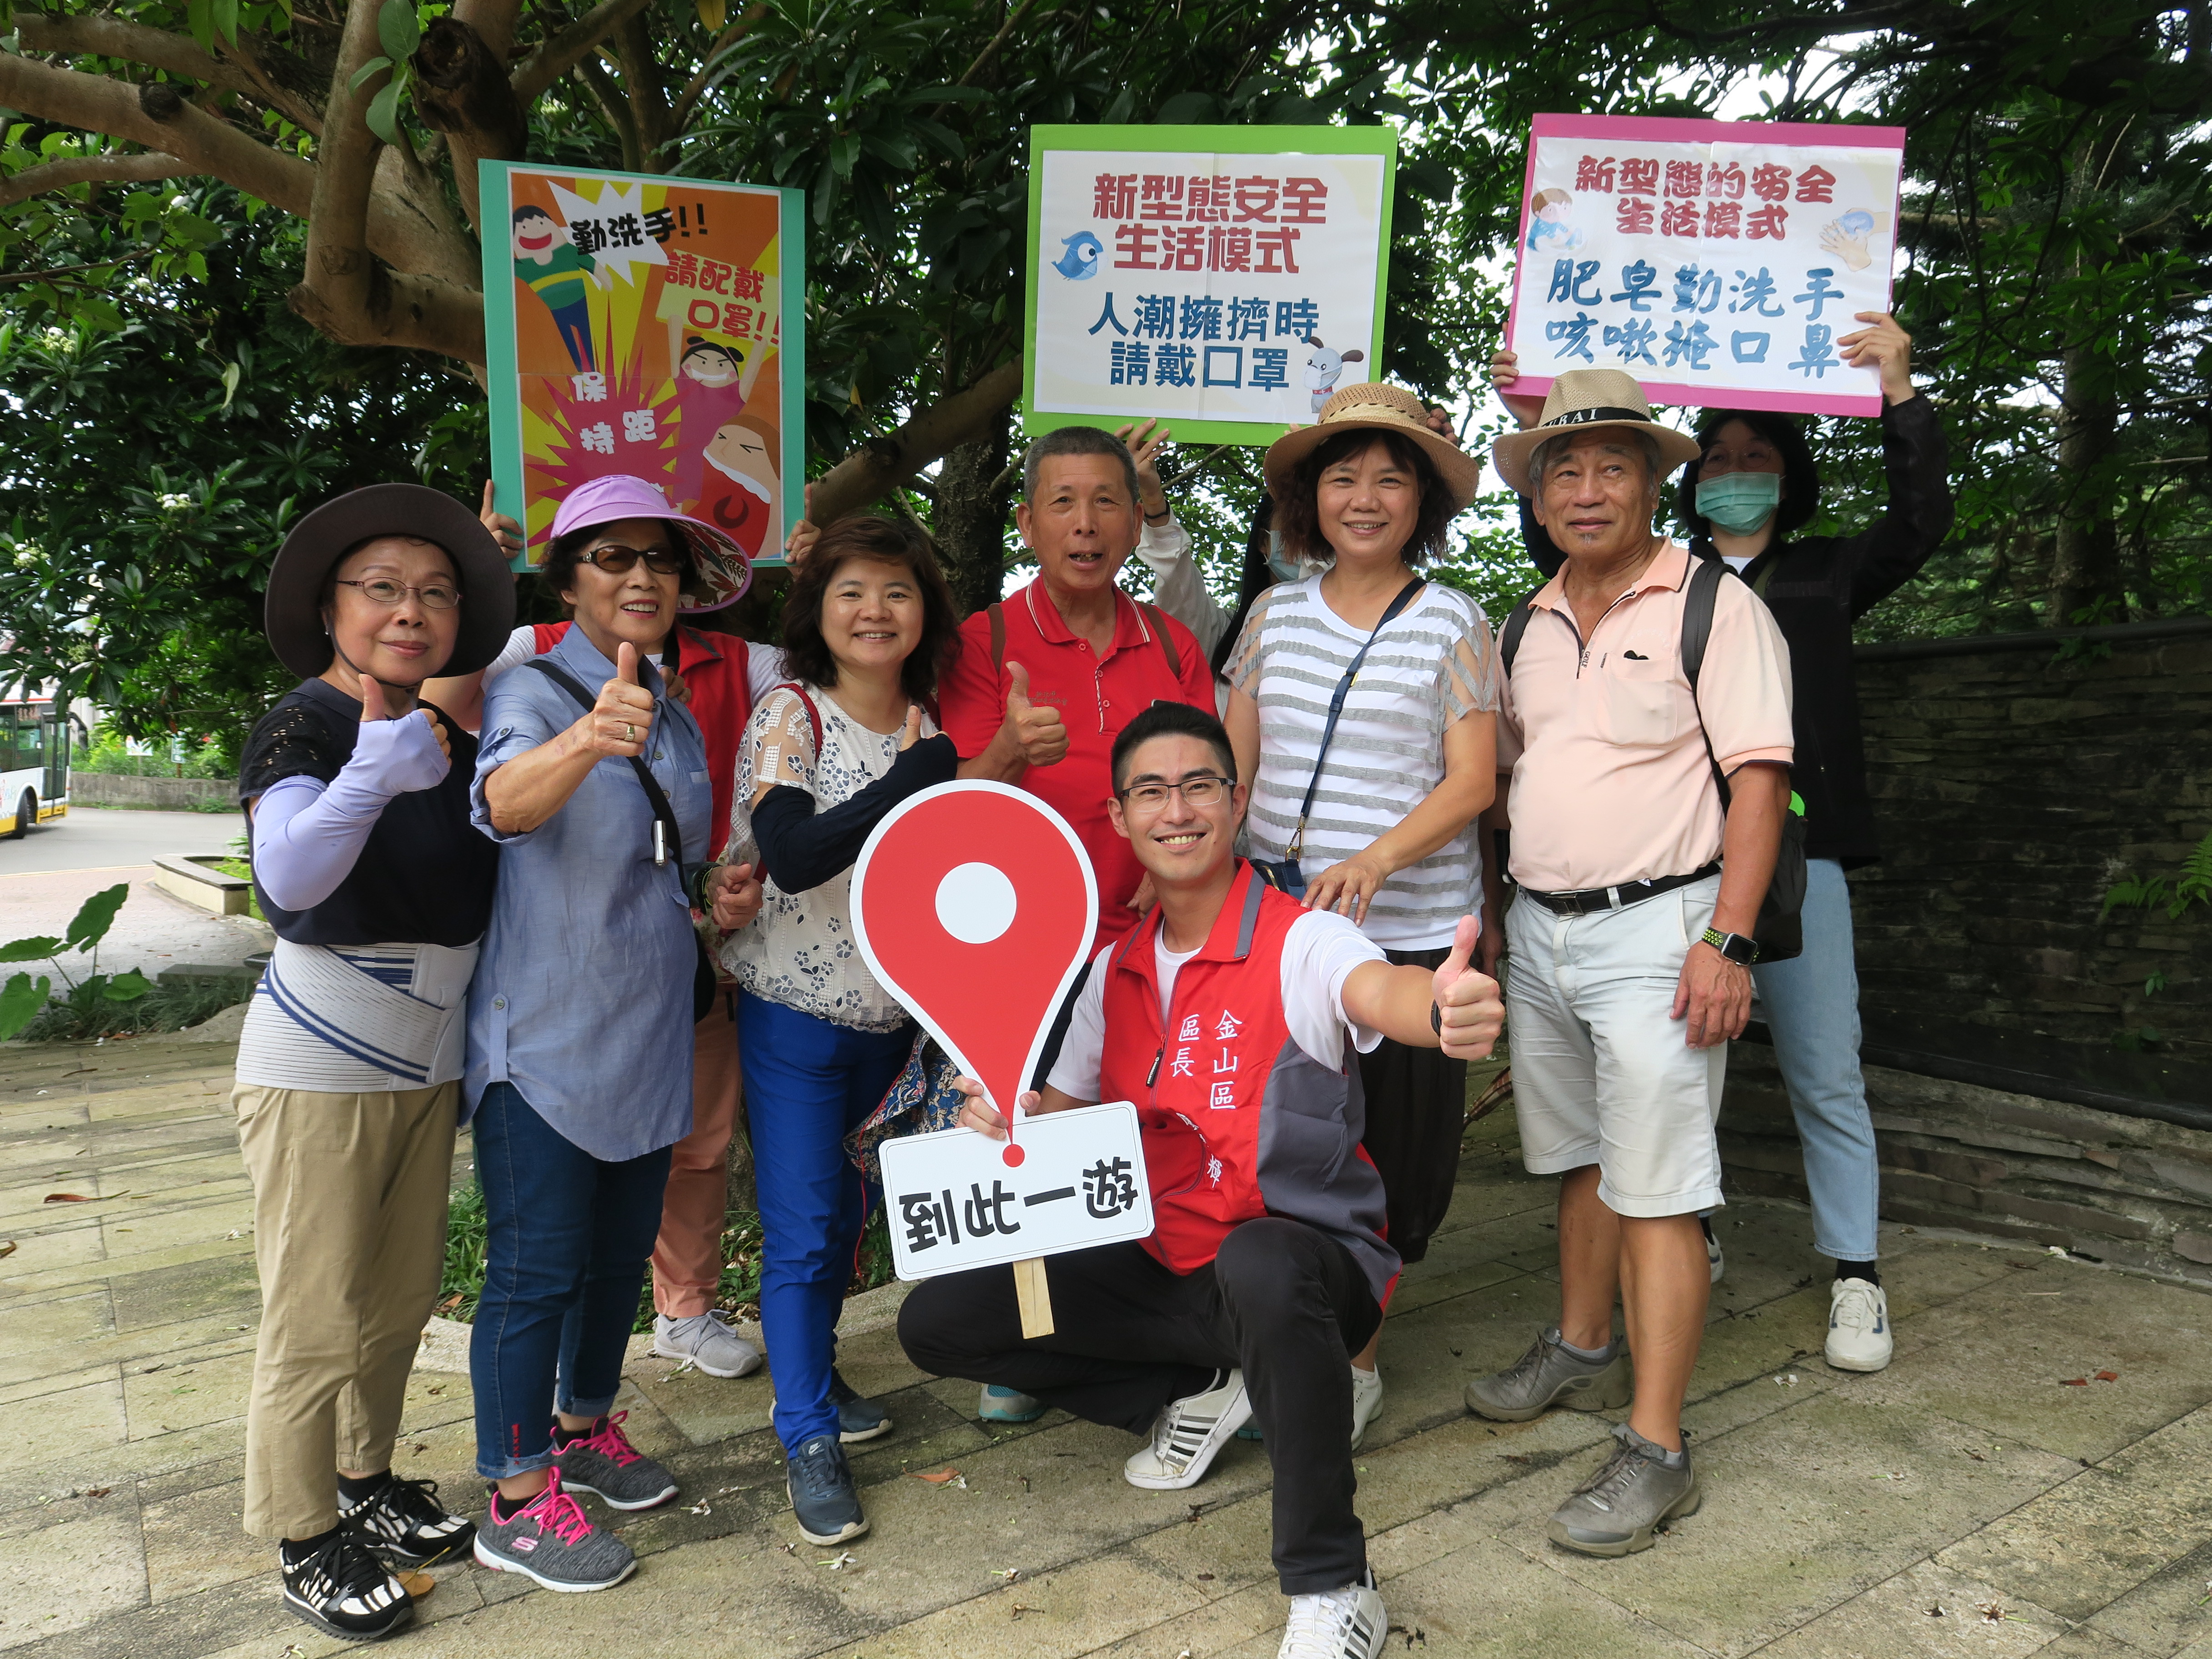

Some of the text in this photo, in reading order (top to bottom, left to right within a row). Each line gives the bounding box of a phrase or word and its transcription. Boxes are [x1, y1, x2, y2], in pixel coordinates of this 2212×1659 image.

[1093, 173, 1328, 225] 新型態安全
[1575, 155, 1836, 204] 新型態的安全
[569, 203, 708, 255] 勤洗手!!
[1615, 200, 1789, 241] 生活模式
[1114, 223, 1301, 274] 生活模式
[664, 251, 764, 303] 請配戴
[1546, 258, 1845, 322] 肥皂勤洗手
[1088, 291, 1320, 344] 人潮擁擠時
[1110, 340, 1290, 392] 請戴口罩
[1545, 311, 1840, 380] 咳嗽掩口鼻
[570, 370, 615, 455] 保持
[1544, 408, 1597, 427] UBAI
[1581, 651, 1590, 668] GOLF
[1170, 1013, 1201, 1078] 區長
[1210, 1009, 1242, 1109] 金山區
[899, 1156, 1138, 1254] 到此一遊
